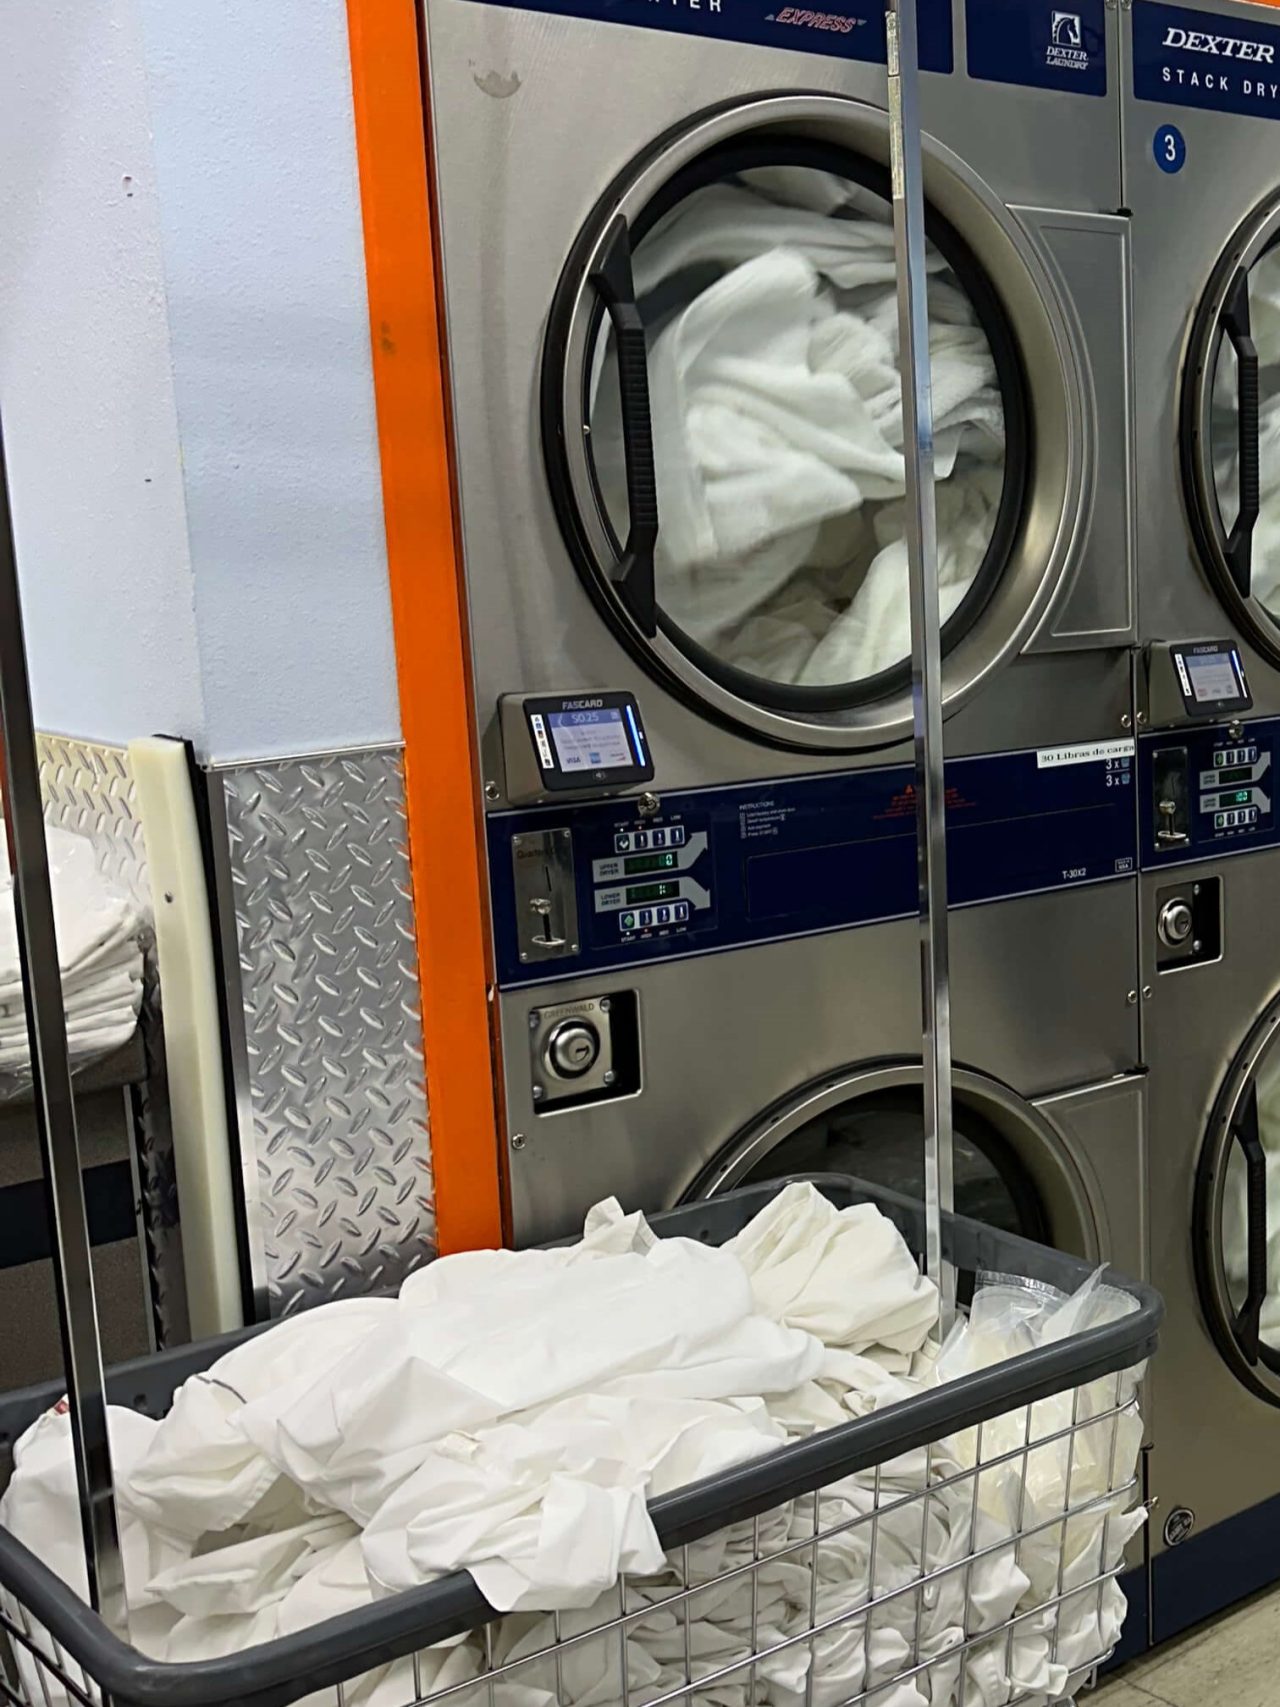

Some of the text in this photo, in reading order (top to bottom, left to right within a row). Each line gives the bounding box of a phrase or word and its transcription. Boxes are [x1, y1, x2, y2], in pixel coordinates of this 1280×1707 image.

[775, 7, 858, 33] EXPRESS
[1163, 27, 1274, 63] DEXTER
[1046, 46, 1088, 61] DEXTER
[1046, 56, 1088, 70] LAUNDRY
[1162, 66, 1229, 91] STACK
[1164, 135, 1176, 161] 3
[562, 699, 604, 710] FASCARD
[1041, 755, 1054, 763] 30
[1057, 751, 1090, 761] Libras
[1106, 775, 1113, 787] 3
[1062, 868, 1087, 880] T-30X2
